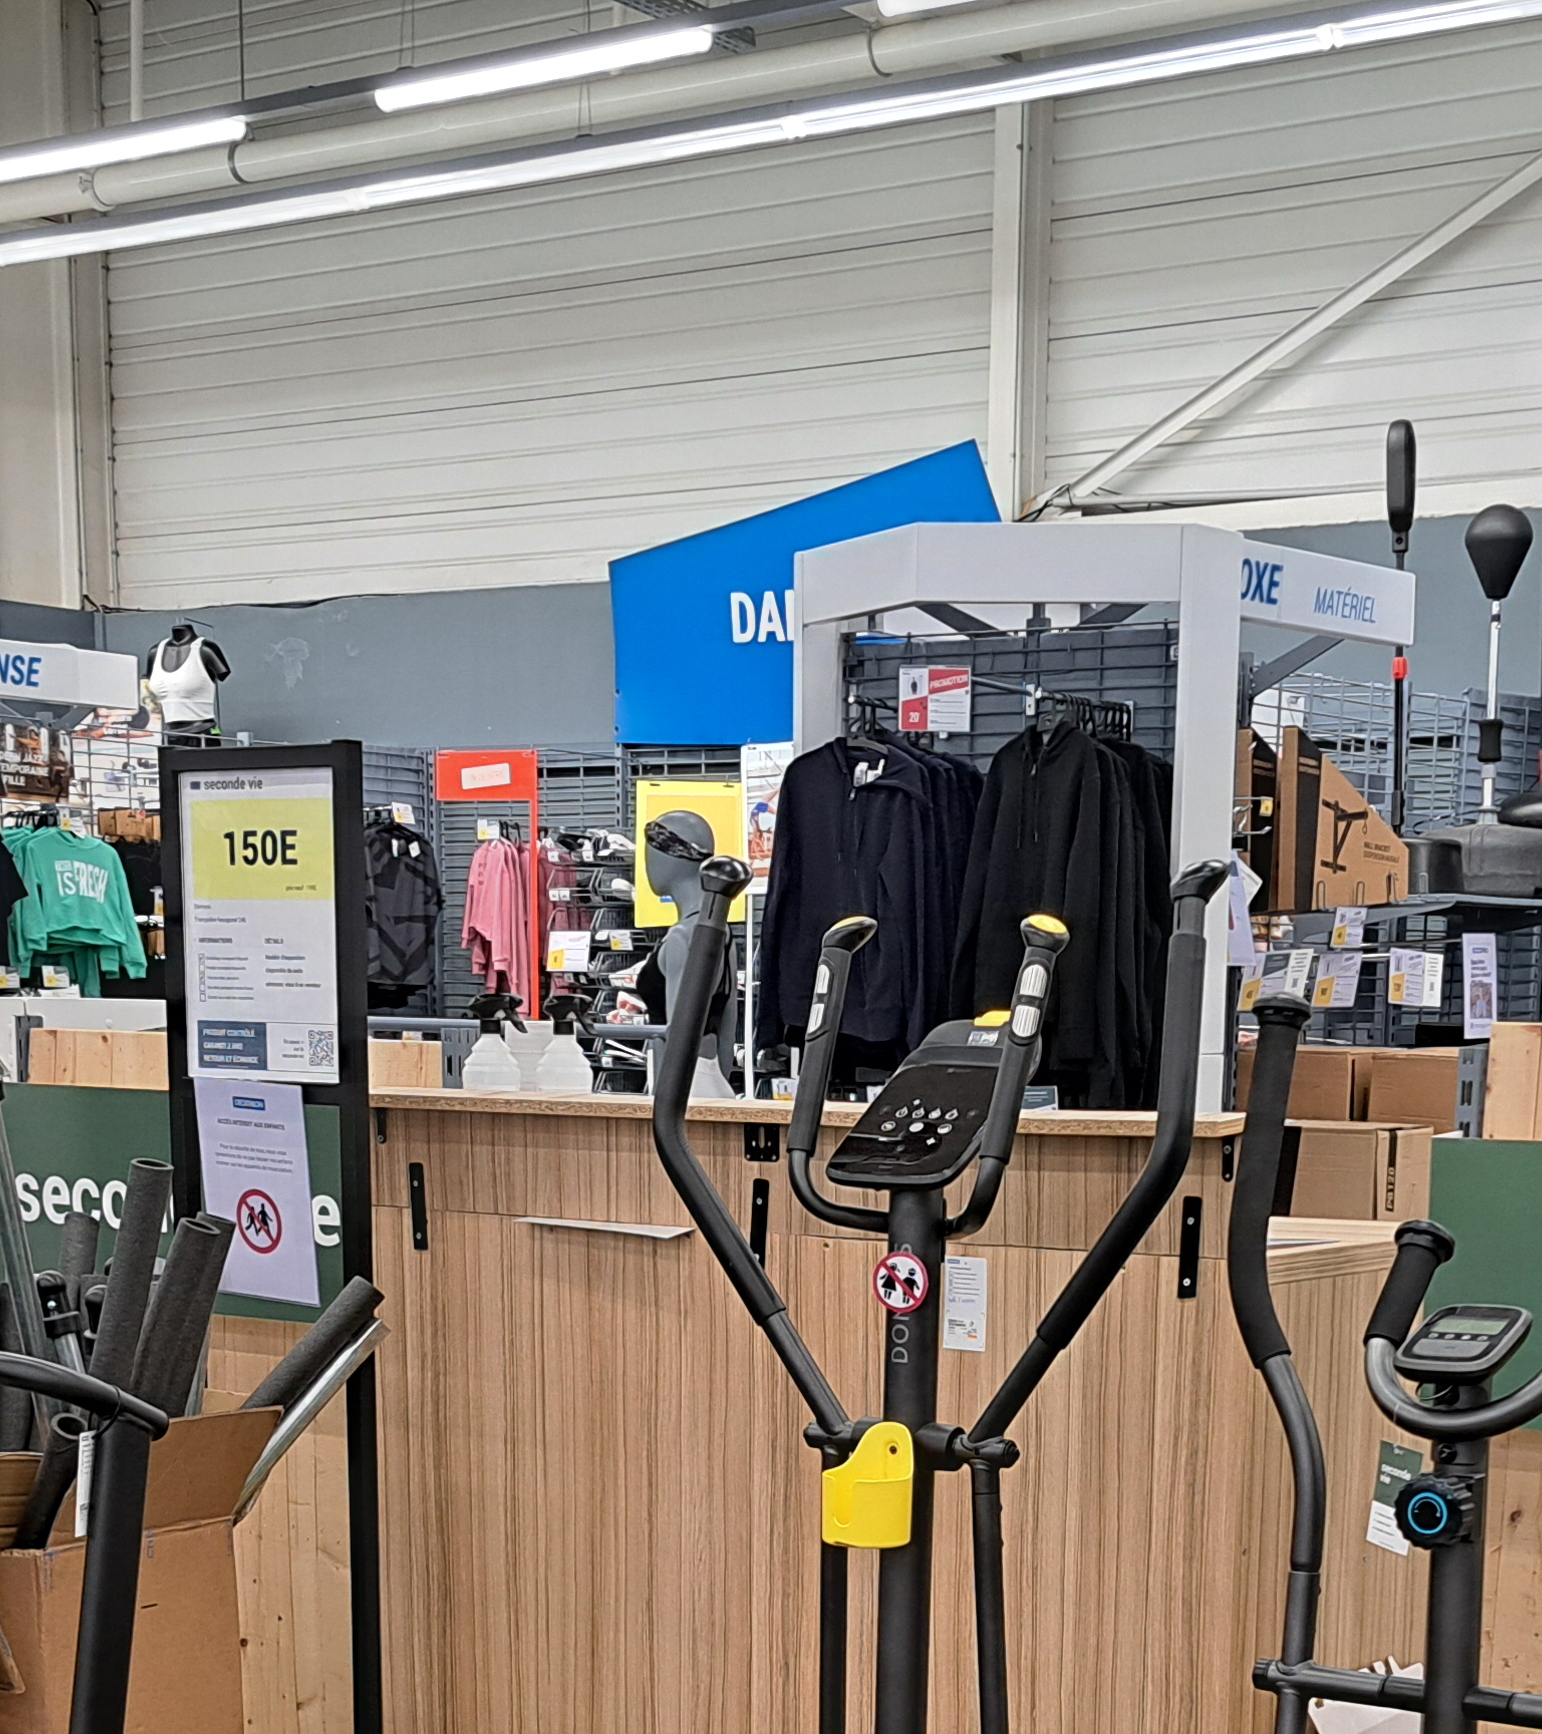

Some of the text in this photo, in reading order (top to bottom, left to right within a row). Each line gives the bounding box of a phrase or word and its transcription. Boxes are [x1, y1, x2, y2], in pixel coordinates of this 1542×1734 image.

[1314, 587, 1376, 624] MATÉRIEL
[929, 674, 968, 689] PROMOTION
[203, 775, 263, 791] seconde vie
[223, 829, 298, 866] 150E
